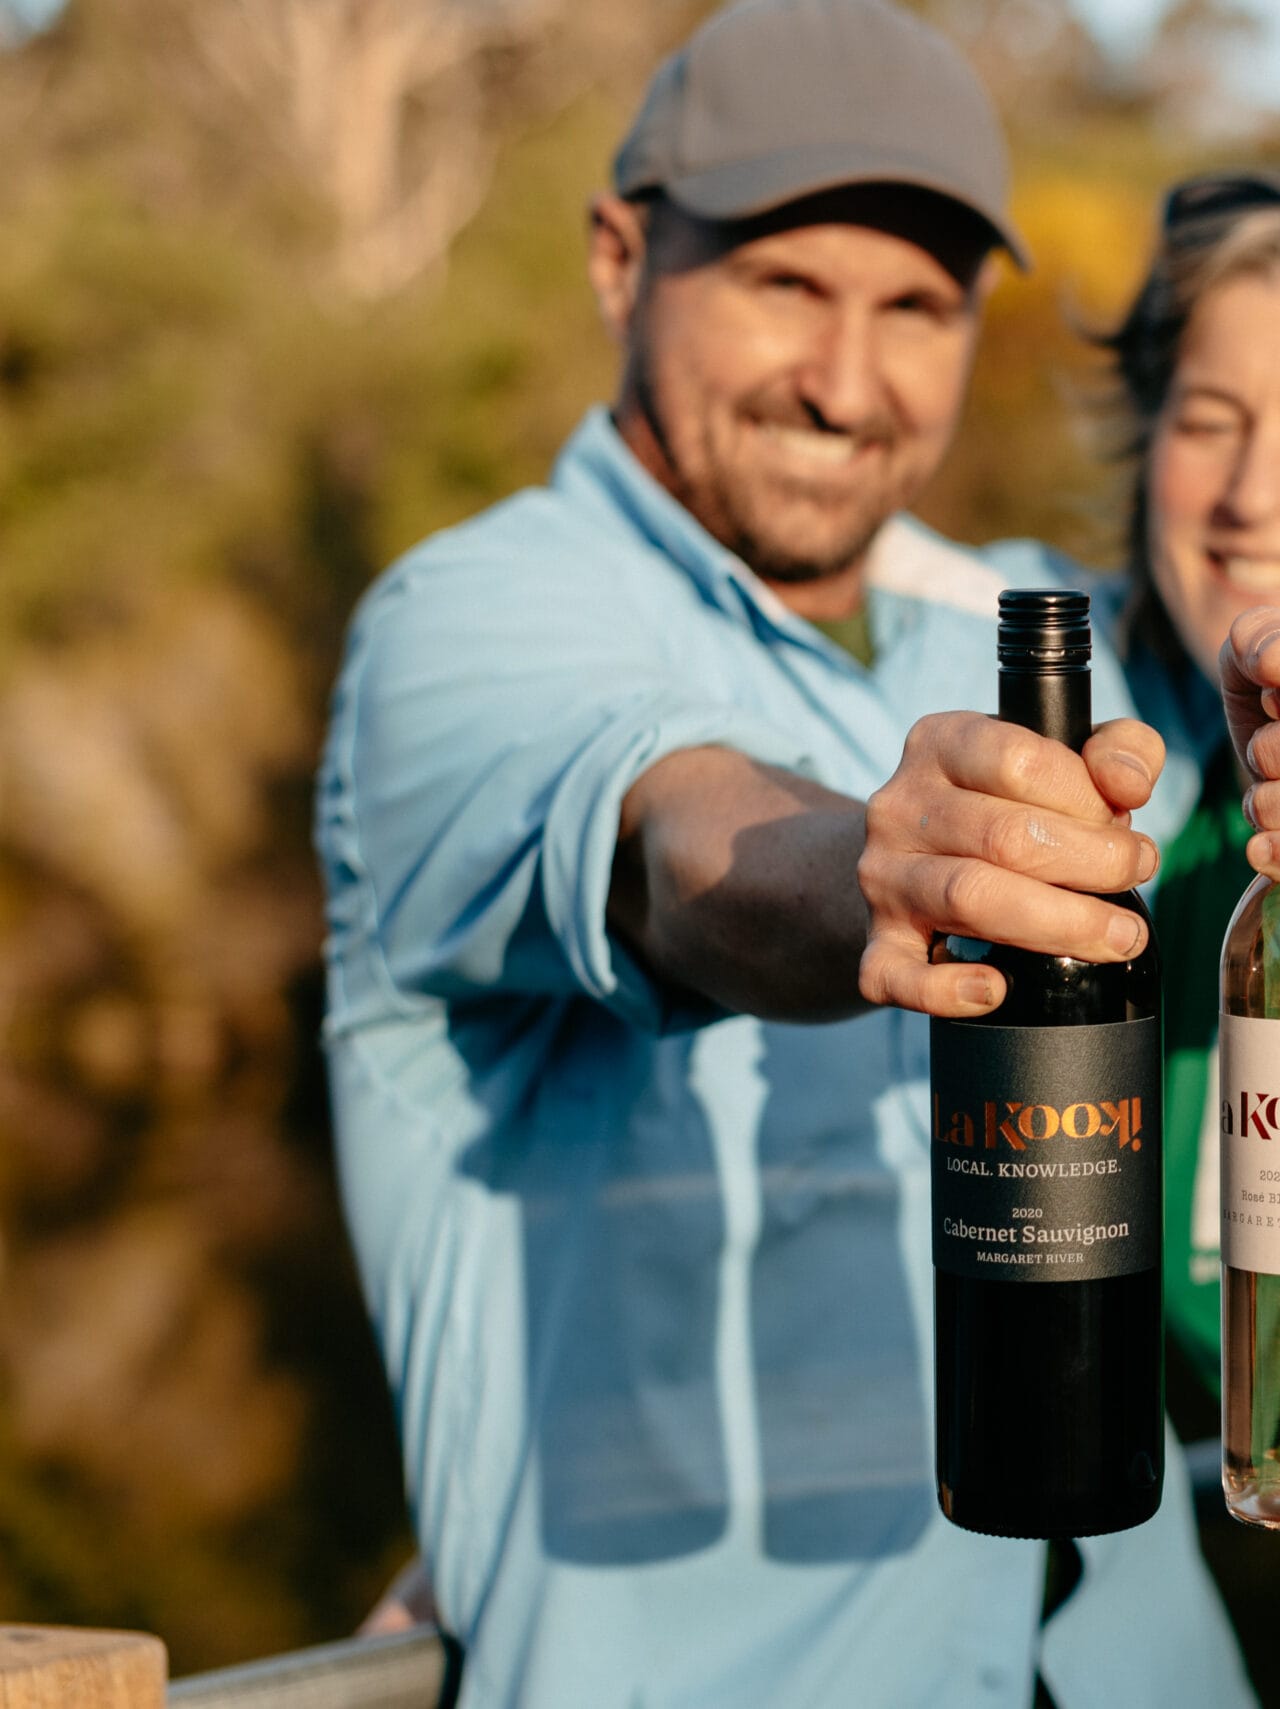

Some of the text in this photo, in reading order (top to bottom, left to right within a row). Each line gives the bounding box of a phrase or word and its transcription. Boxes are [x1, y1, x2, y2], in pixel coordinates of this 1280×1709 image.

[934, 1091, 974, 1148] La
[1222, 1100, 1234, 1136] a
[946, 1156, 1122, 1178] LOCAL. KNOWLEDGE.
[1241, 1190, 1265, 1203] Rosé
[1012, 1207, 1044, 1219] 2020
[943, 1217, 1130, 1246] Cabernet Sauvignon
[977, 1251, 1084, 1264] MARGARET RIVER
